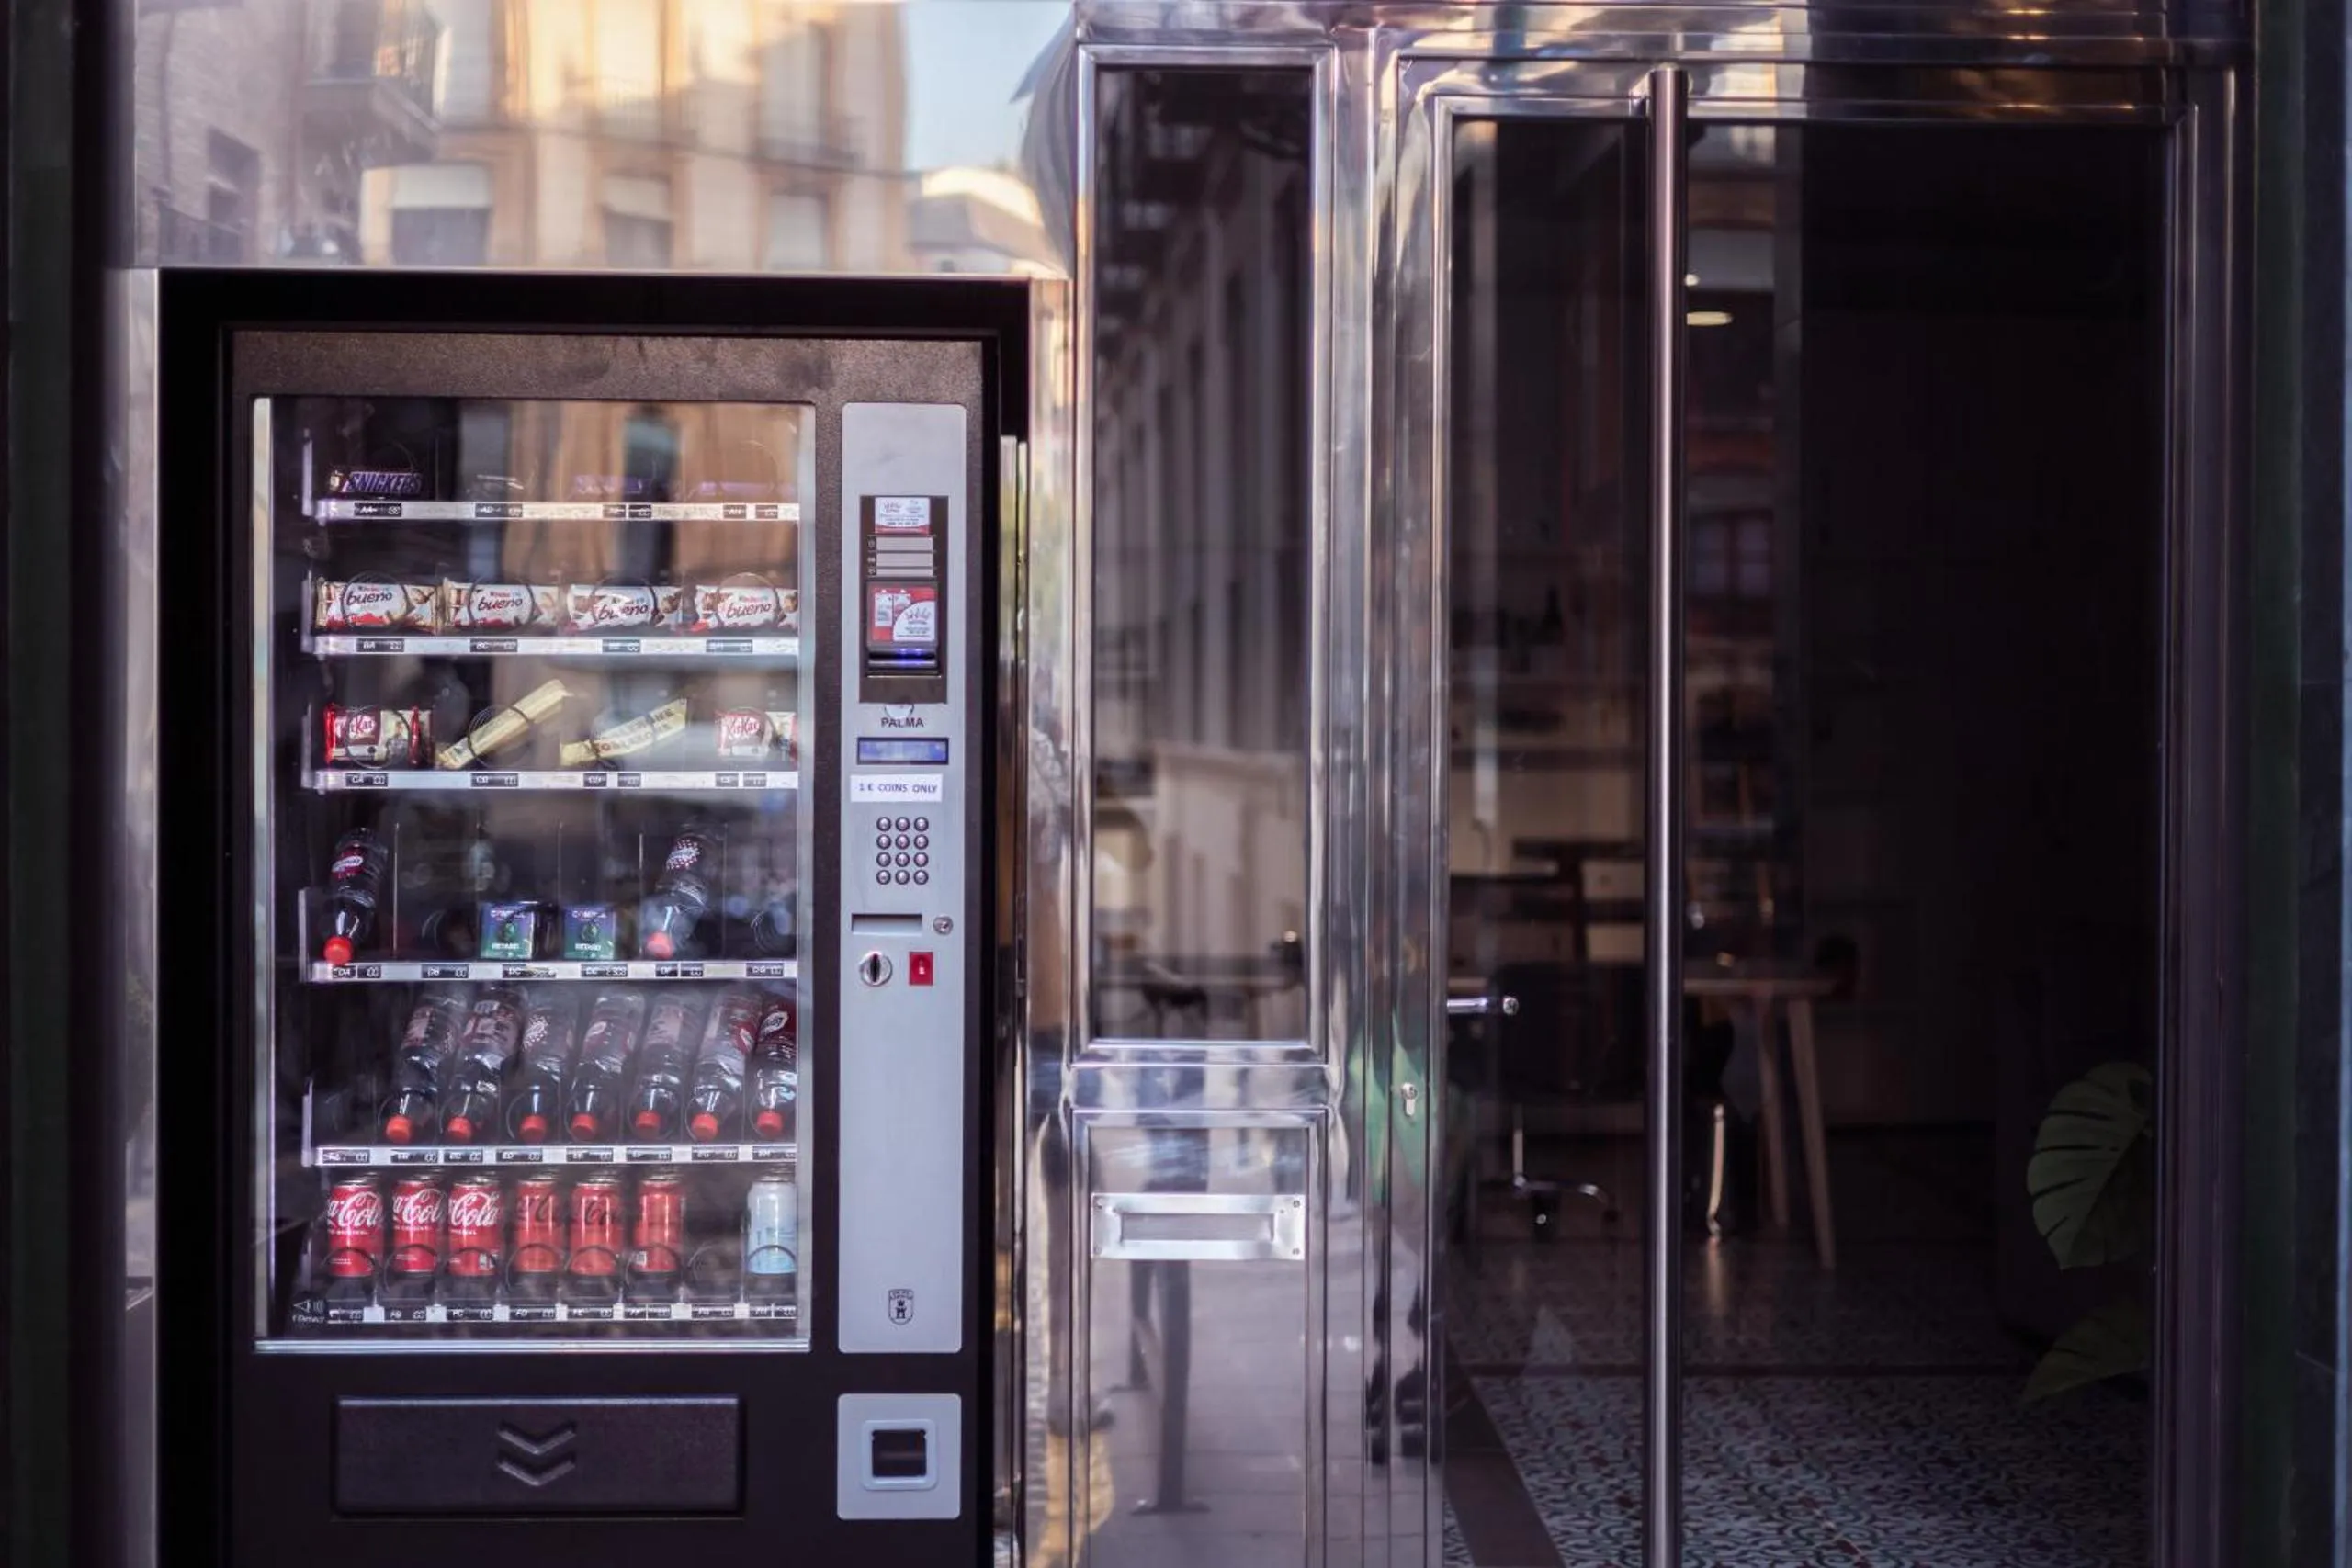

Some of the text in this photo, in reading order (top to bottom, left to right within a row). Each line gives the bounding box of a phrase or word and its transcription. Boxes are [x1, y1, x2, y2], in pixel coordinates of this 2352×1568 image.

[349, 472, 423, 493] SNICKERS
[345, 591, 393, 606] bueno
[477, 596, 524, 611] bueno
[727, 602, 772, 619] bueno
[881, 717, 924, 728] PALMA
[859, 783, 865, 791] 1
[877, 783, 908, 792] COINS
[911, 784, 937, 794] ONLY
